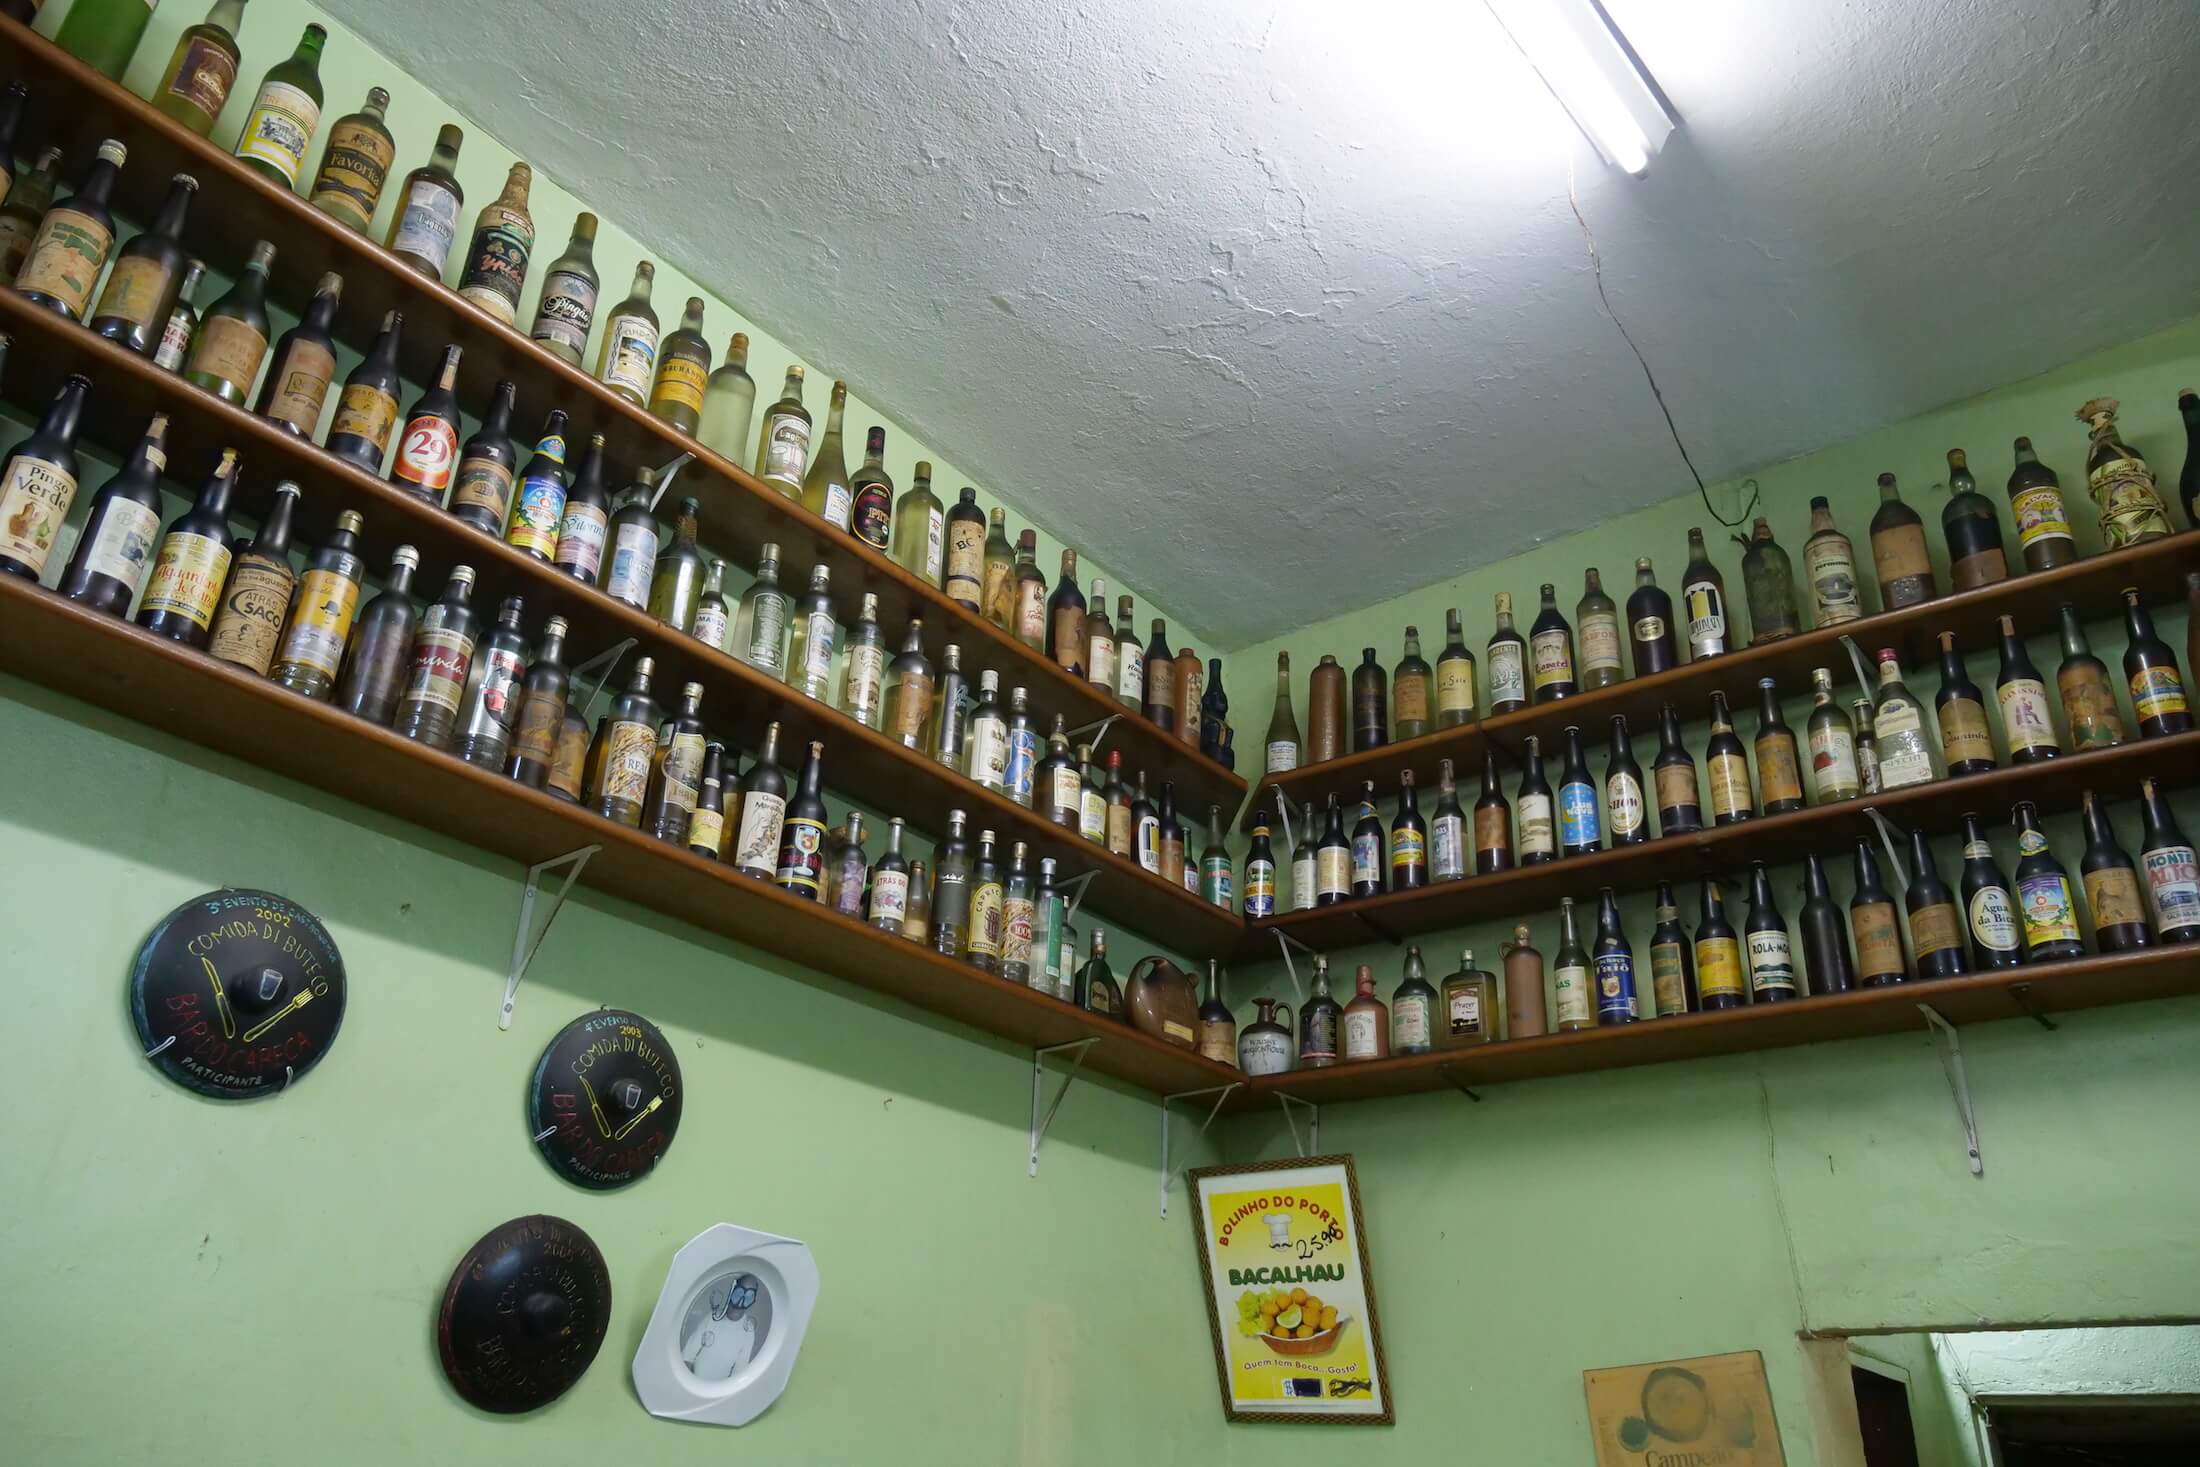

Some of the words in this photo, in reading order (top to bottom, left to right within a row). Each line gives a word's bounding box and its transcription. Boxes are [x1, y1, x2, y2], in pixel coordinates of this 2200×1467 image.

[410, 432, 449, 463] 29
[17, 476, 66, 512] Verde
[30, 466, 69, 494] Pingo
[243, 600, 281, 628] SACO
[1607, 799, 1639, 812] SHOW
[2146, 852, 2193, 870] MONTE
[224, 896, 270, 910] EVENTO
[254, 908, 292, 929] 2002
[1977, 914, 1992, 926] da
[187, 920, 259, 957] COMIDA
[263, 922, 280, 944] DI
[282, 934, 329, 998] BUTECO
[180, 1056, 263, 1087] PARTICIPANTE
[570, 1037, 623, 1076] COMIDA
[624, 1036, 635, 1053] DI
[637, 1040, 675, 1099] BUTECO
[1219, 1197, 1269, 1248] BOLINHO
[1272, 1195, 1295, 1209] DO
[1299, 1198, 1345, 1241] PORTO
[1228, 1262, 1346, 1287] BACALHAU
[1243, 1359, 1273, 1371] Quem
[1274, 1359, 1293, 1368] tem
